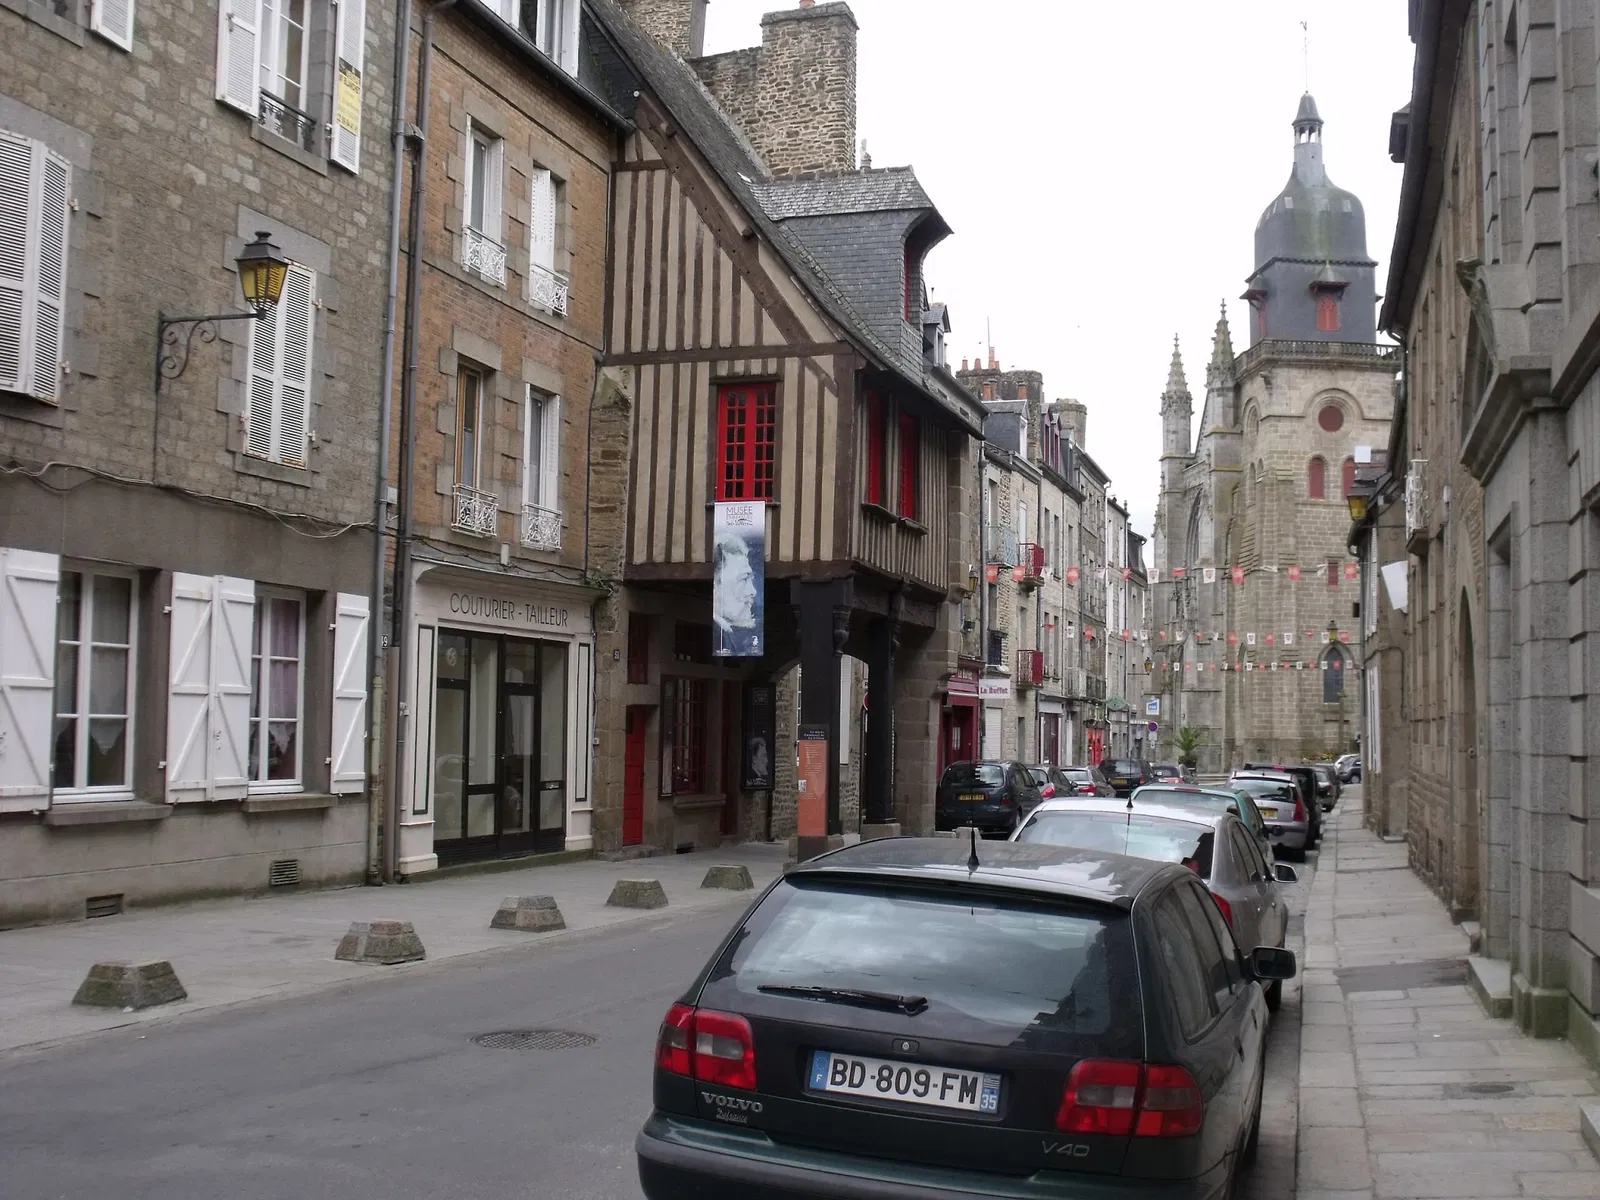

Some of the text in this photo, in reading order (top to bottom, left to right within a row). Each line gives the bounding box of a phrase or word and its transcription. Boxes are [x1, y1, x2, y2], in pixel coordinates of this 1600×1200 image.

[726, 505, 753, 515] MUSÉE
[450, 592, 515, 621] COUTURIER
[525, 603, 568, 627] TAILLEUR
[816, 1058, 997, 1110] F BD-809-FM 35
[701, 1091, 763, 1113] VOLVO
[1042, 1140, 1090, 1157] V40
